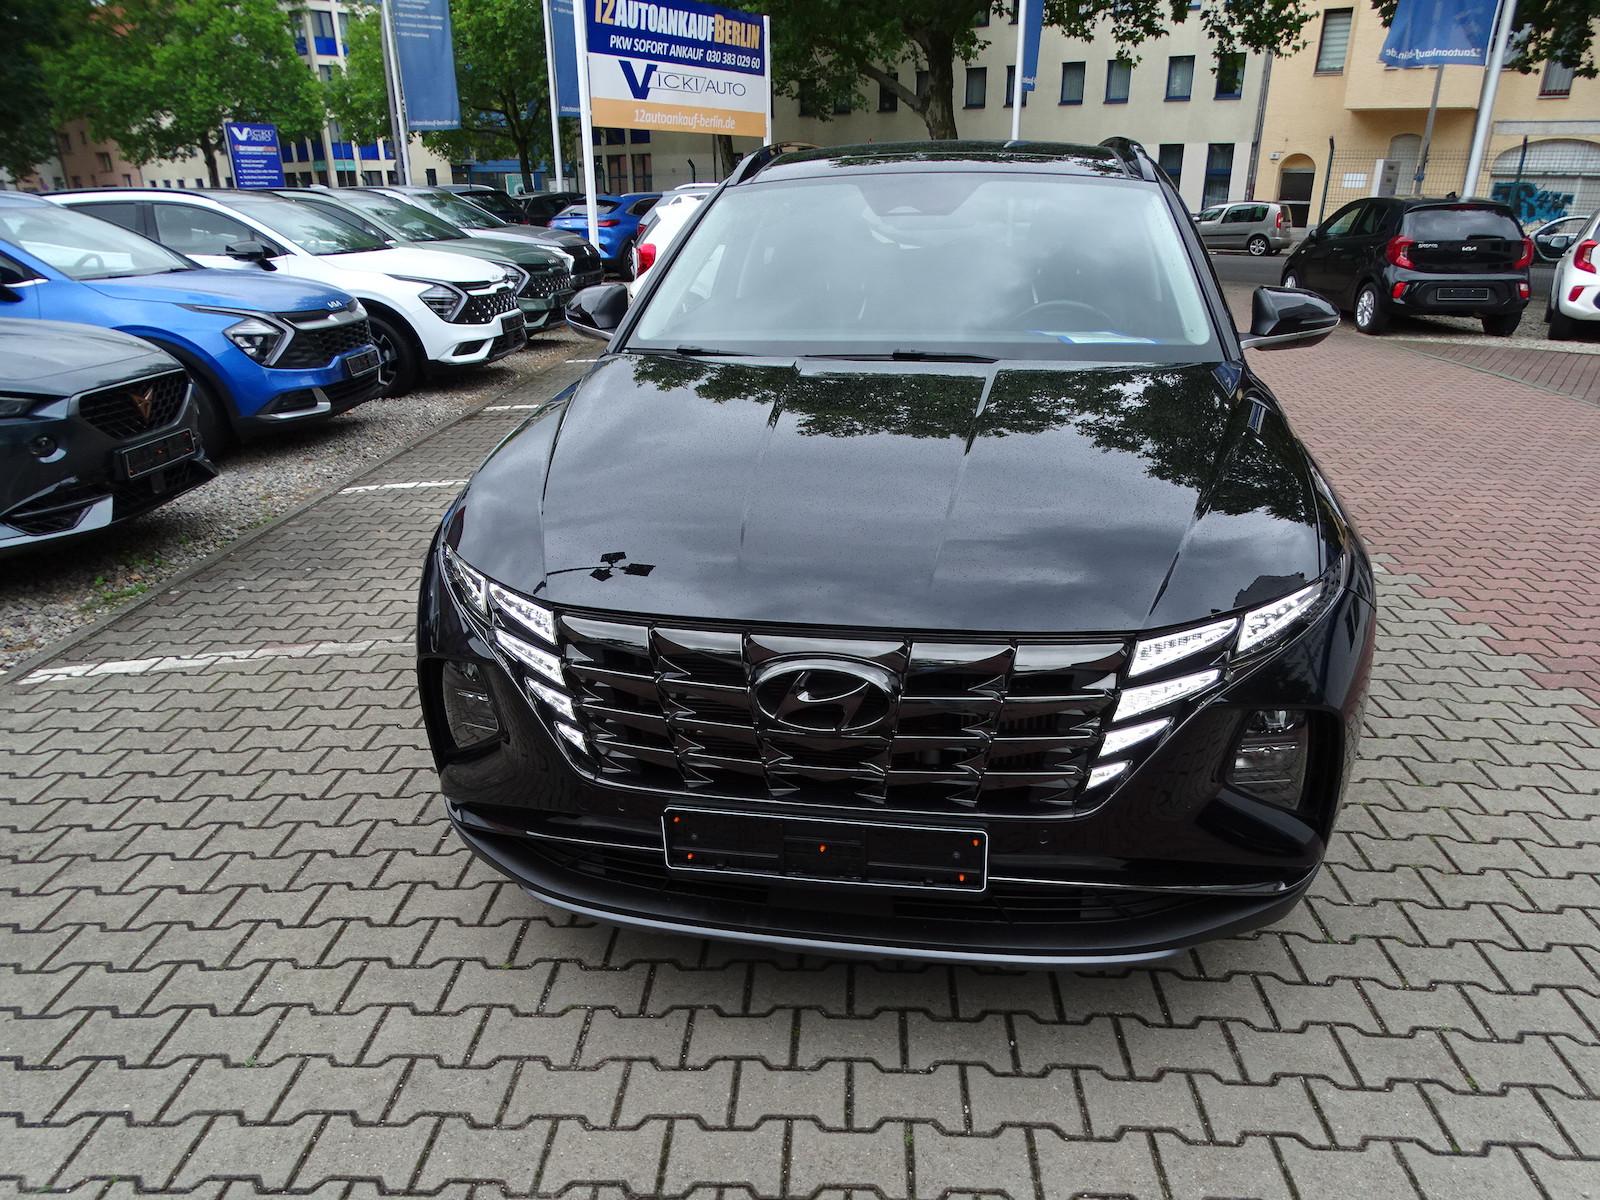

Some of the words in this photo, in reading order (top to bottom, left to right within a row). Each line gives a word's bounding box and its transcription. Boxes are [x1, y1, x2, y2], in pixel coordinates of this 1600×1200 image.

[610, 34, 632, 50] PKW
[634, 38, 670, 56] SOFORT
[669, 44, 704, 61] ANKAUF
[706, 51, 721, 63] 030
[722, 53, 736, 66] 383
[736, 55, 751, 67] 029
[751, 57, 761, 69] 60
[618, 60, 699, 100] VICKI
[634, 108, 736, 129] 12autoankauf-berlin.de
